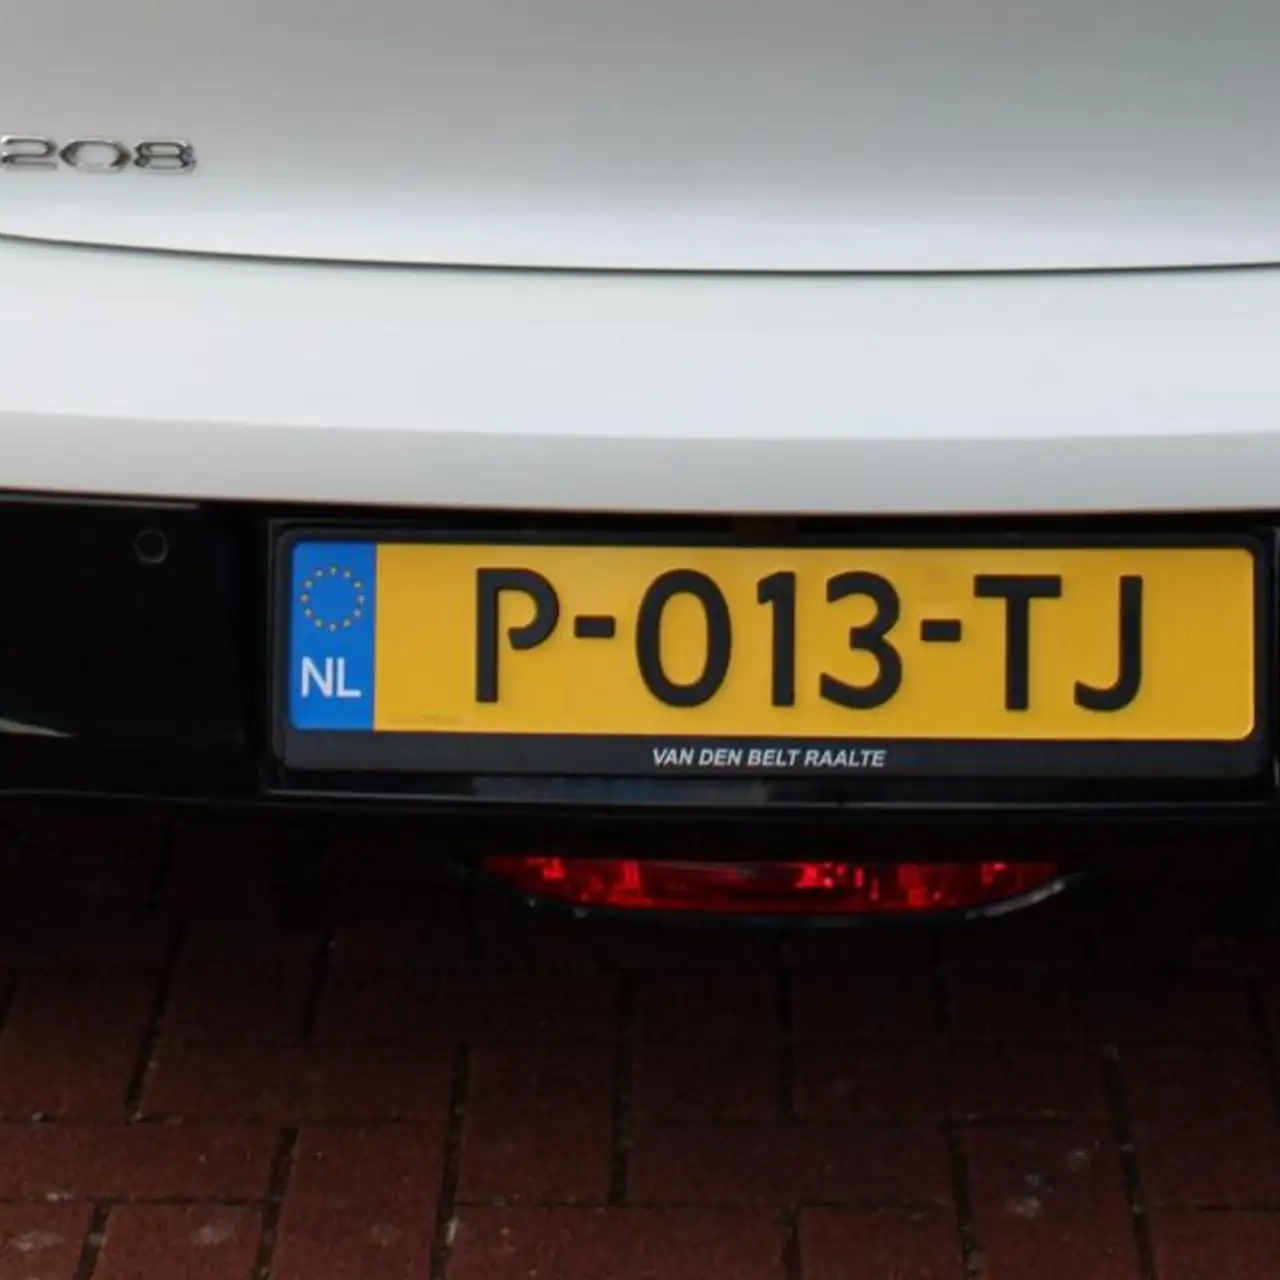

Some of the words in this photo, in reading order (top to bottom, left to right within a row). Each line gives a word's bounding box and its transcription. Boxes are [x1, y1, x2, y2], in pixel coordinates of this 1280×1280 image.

[473, 567, 1144, 713] P-013-TJ
[300, 657, 362, 701] NL
[652, 747, 695, 767] VAN
[698, 748, 744, 767] DEN
[747, 748, 802, 768] BELT
[803, 749, 888, 769] RAALTE
